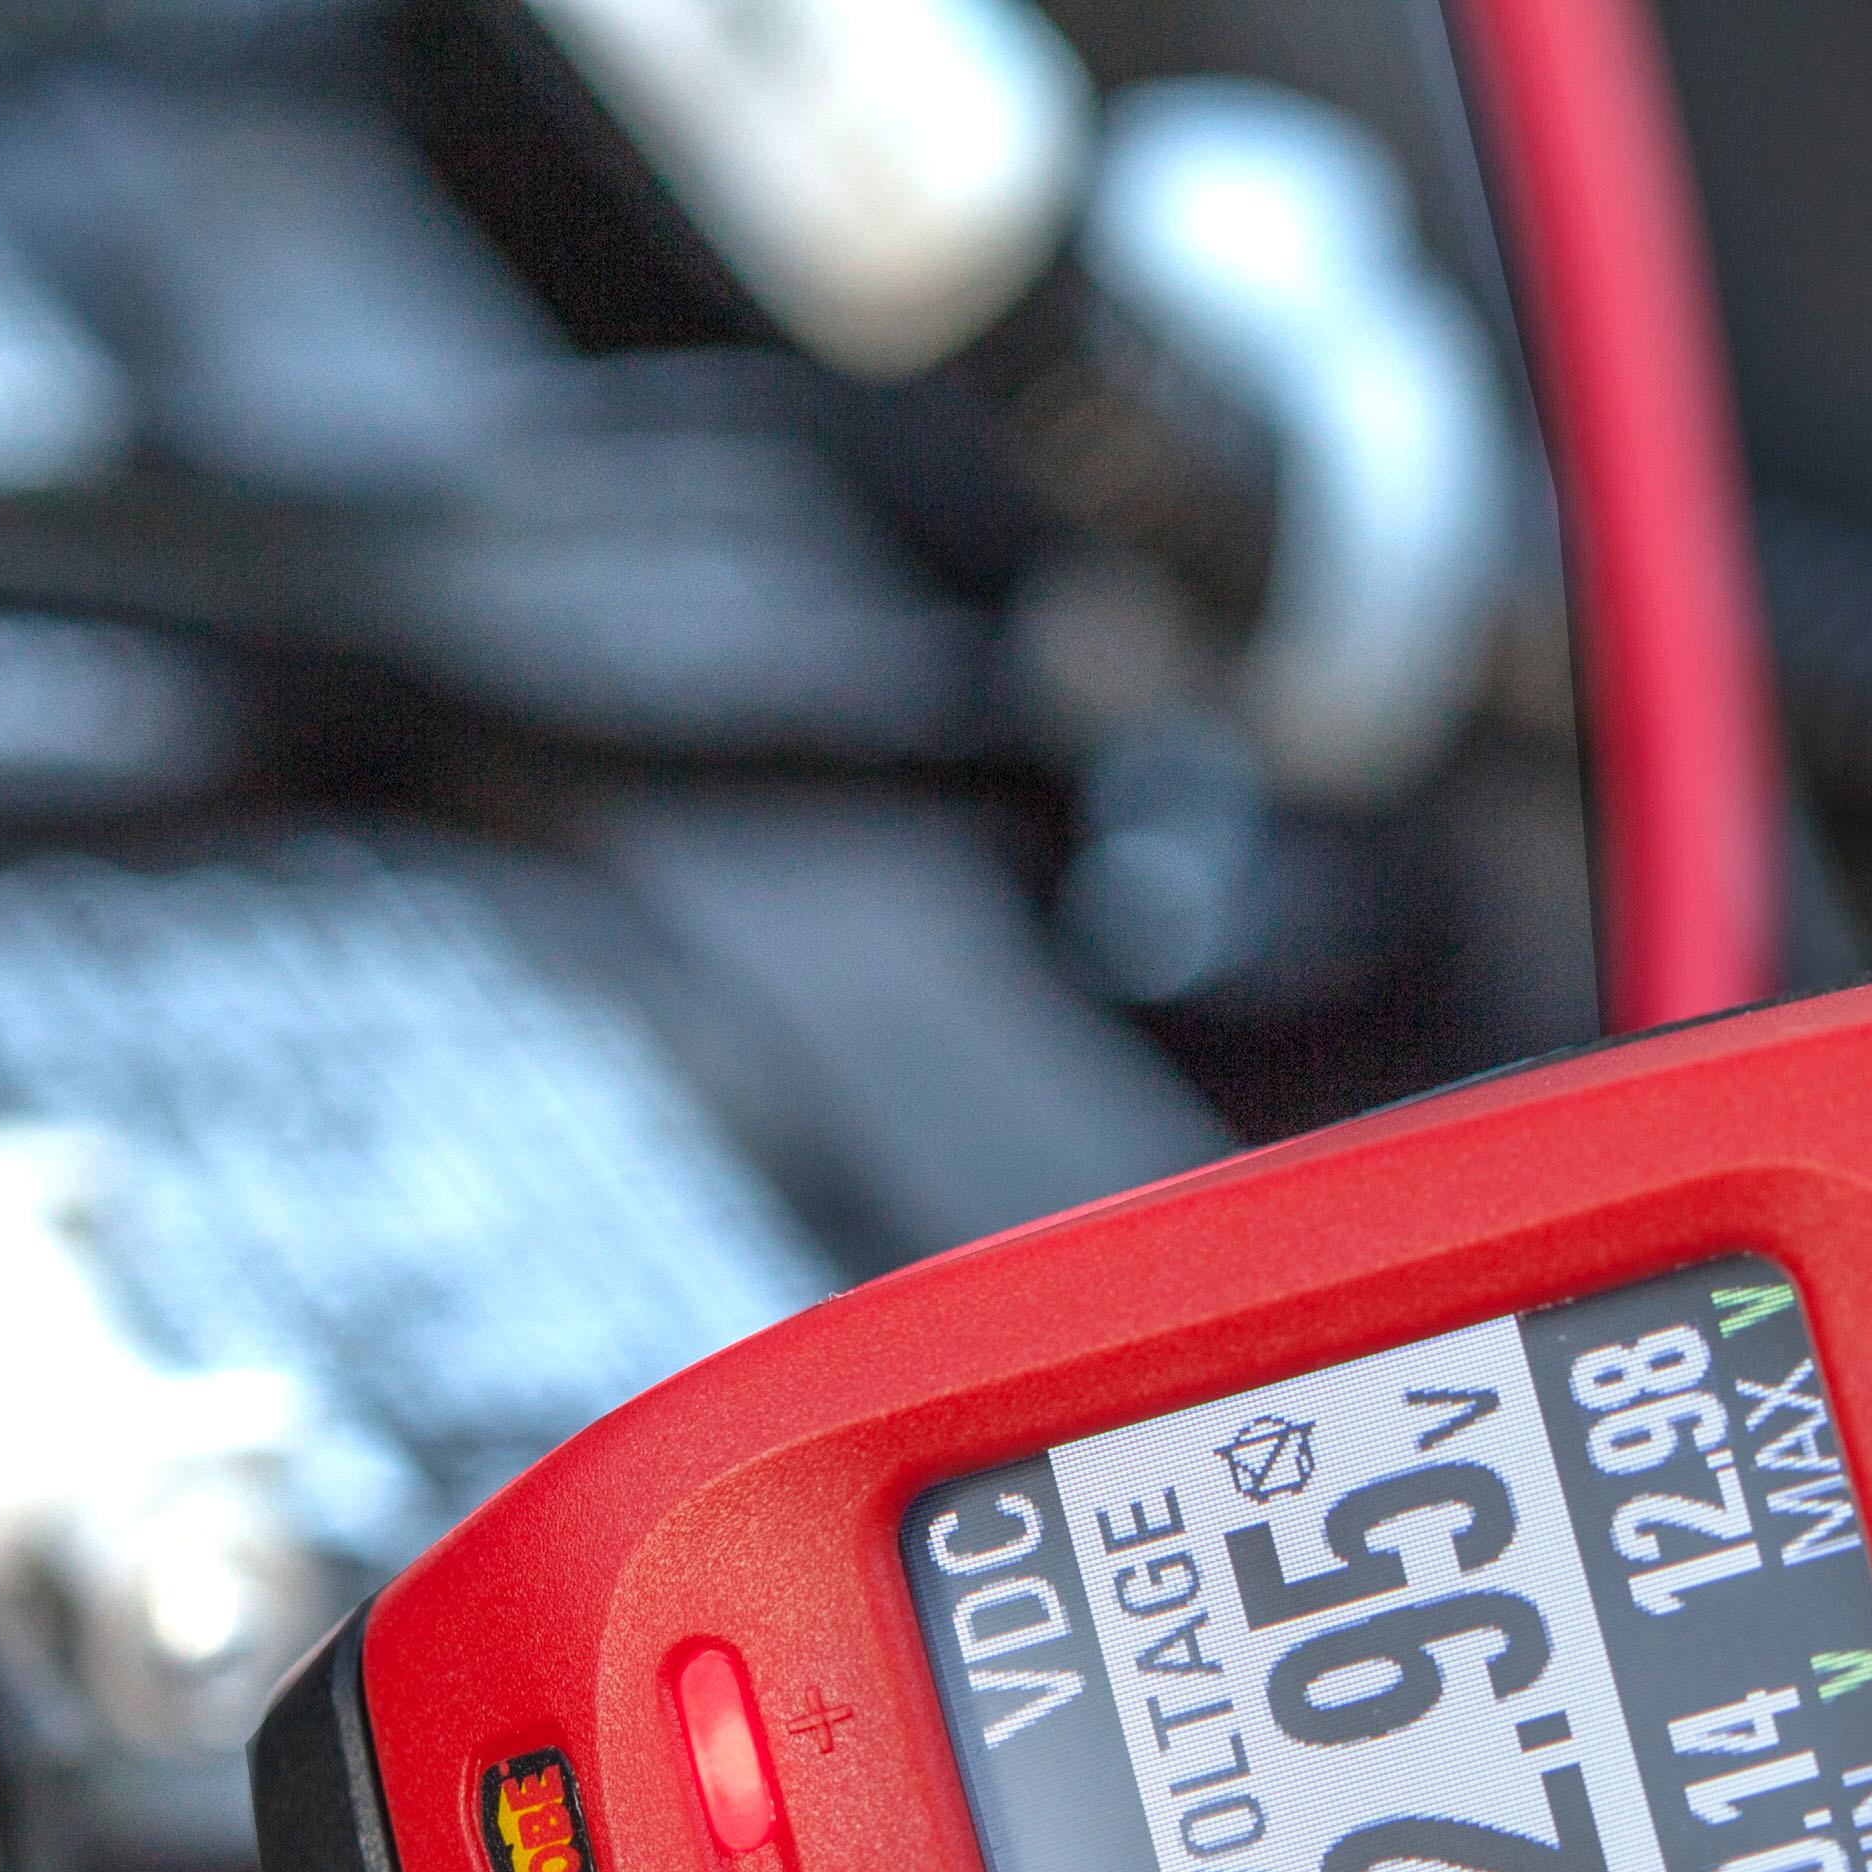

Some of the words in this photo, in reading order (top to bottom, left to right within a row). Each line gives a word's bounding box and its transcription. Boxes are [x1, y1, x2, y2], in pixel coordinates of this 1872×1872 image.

[1569, 1323, 1763, 1616] 12.98
[1735, 1357, 1862, 1567] MAX
[927, 1491, 1085, 1750] VDC
